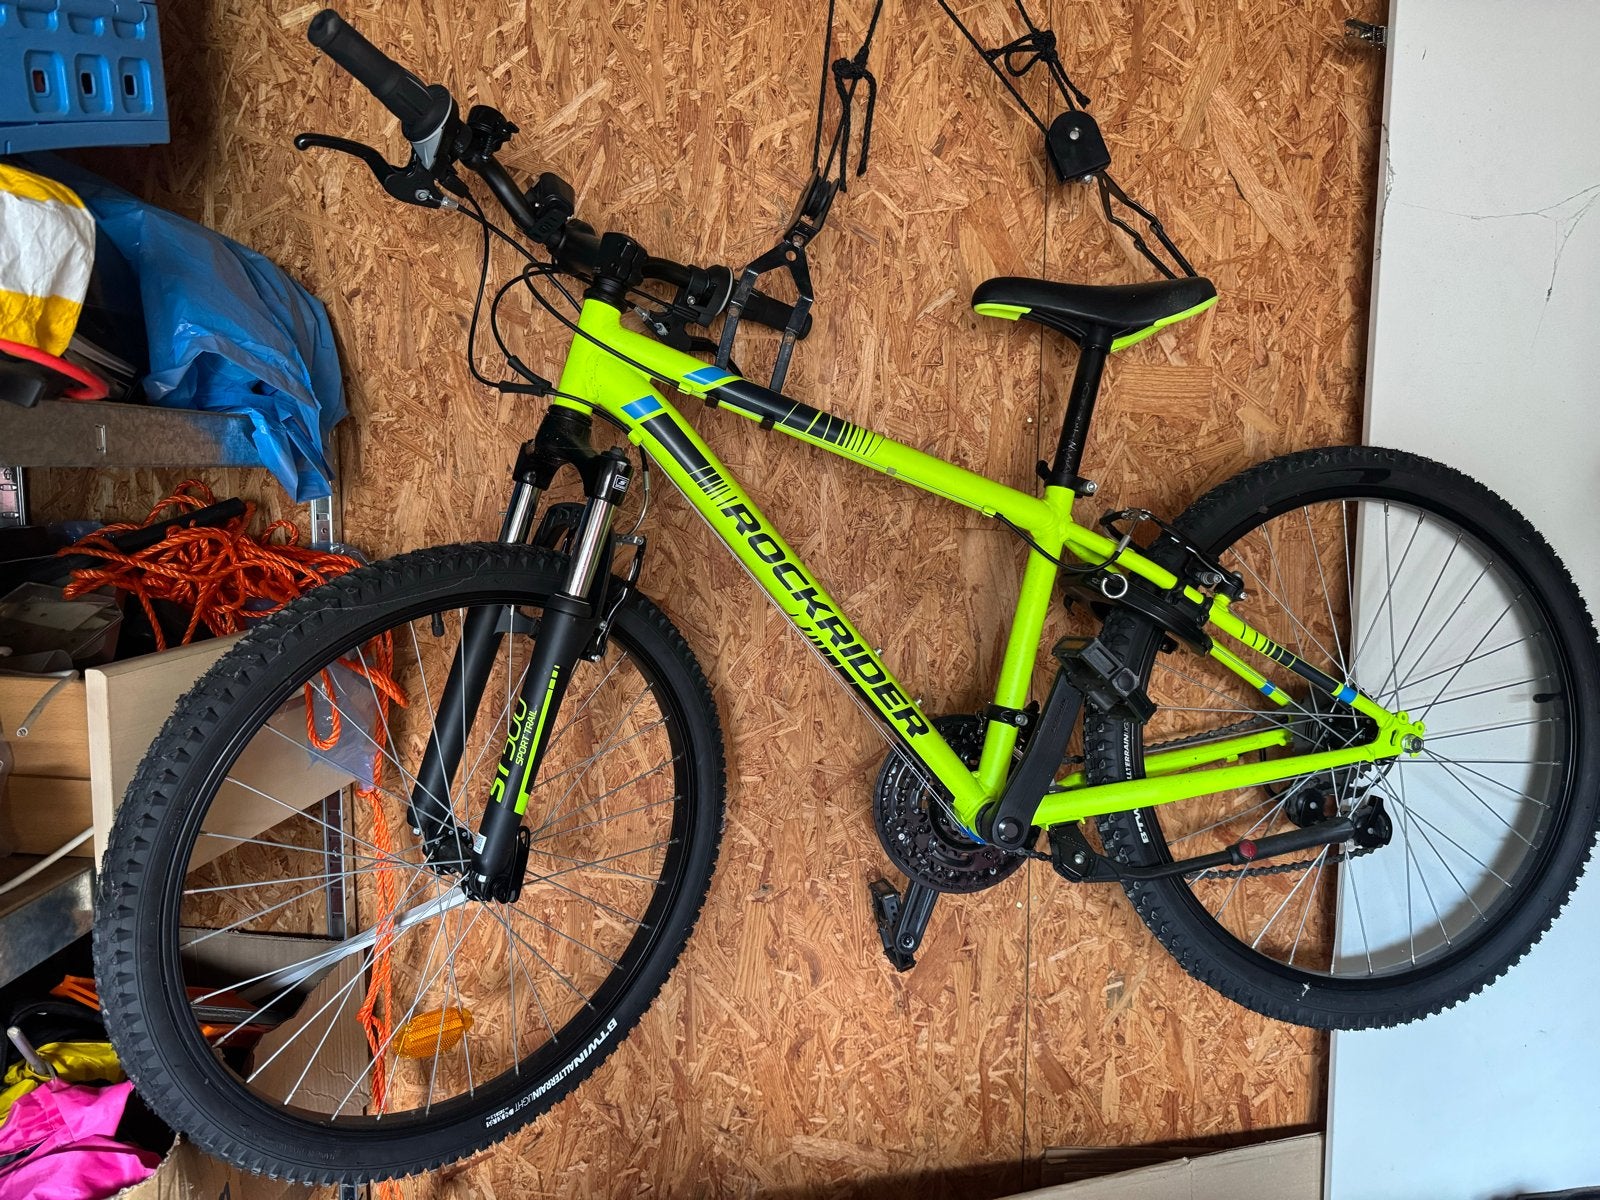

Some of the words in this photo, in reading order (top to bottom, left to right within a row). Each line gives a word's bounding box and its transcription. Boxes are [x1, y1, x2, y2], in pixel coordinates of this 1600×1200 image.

[720, 502, 930, 738] ROCKRIDER
[515, 734, 530, 766] SPORT
[523, 710, 537, 734] TRAIL
